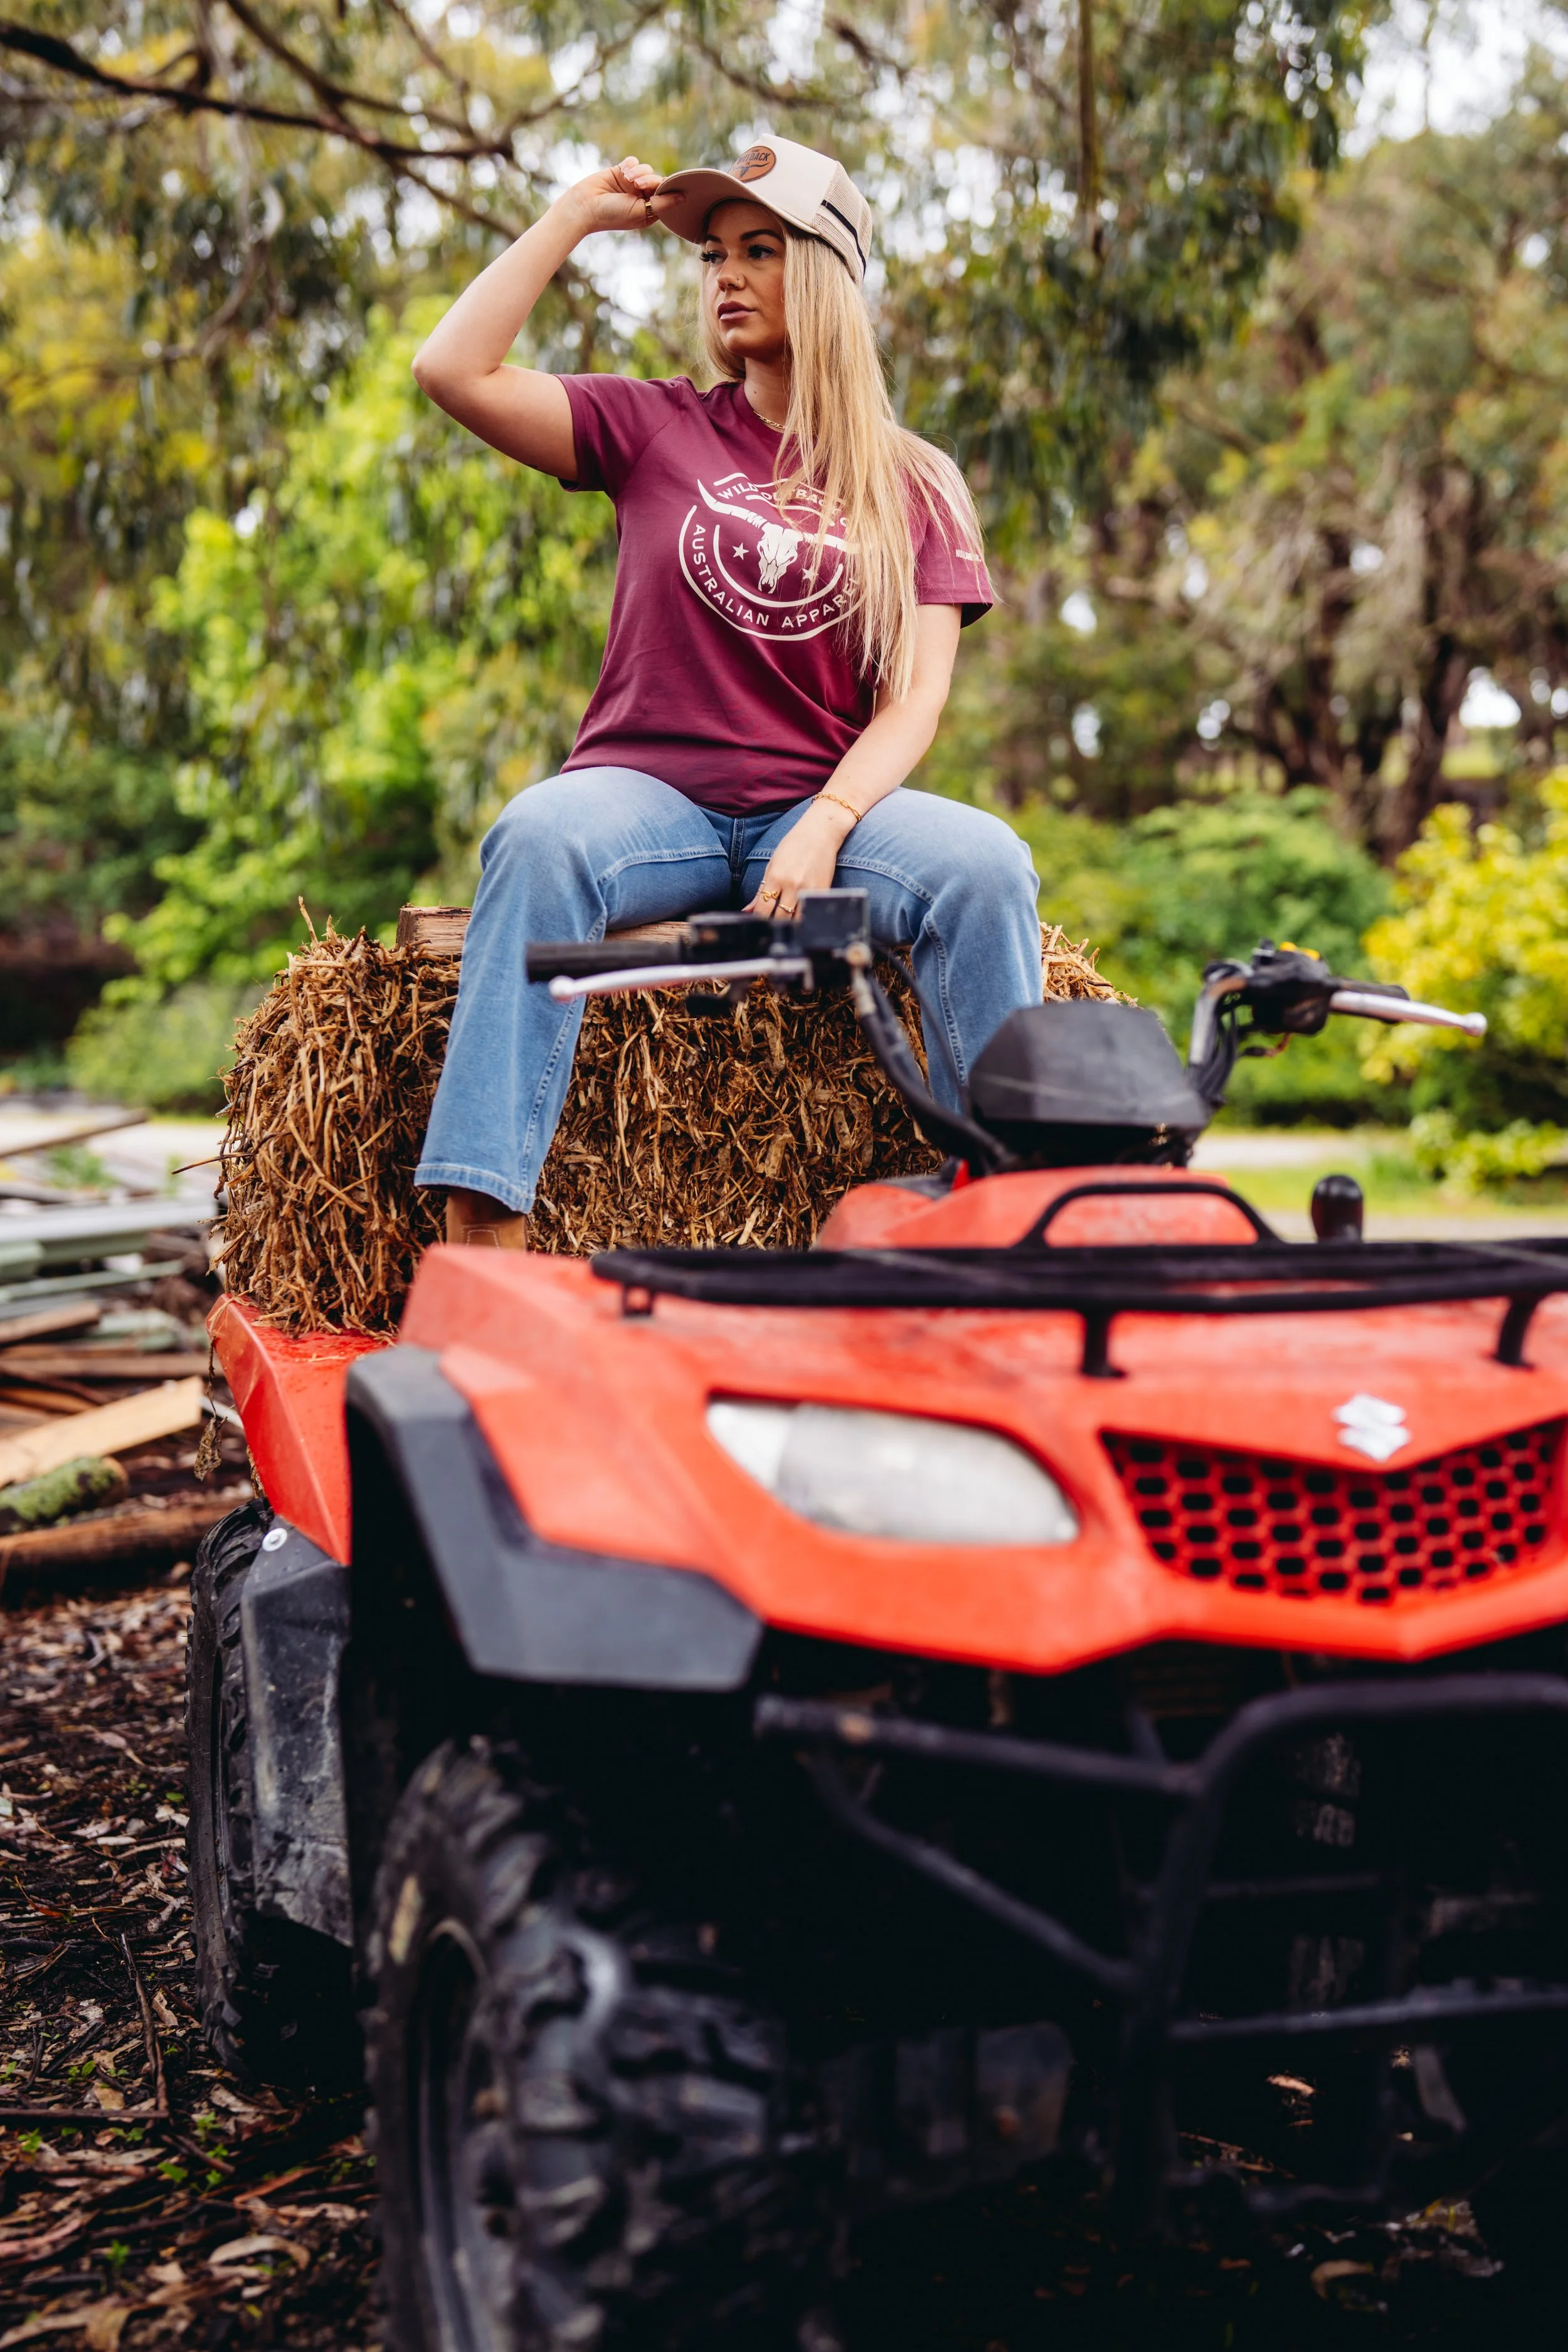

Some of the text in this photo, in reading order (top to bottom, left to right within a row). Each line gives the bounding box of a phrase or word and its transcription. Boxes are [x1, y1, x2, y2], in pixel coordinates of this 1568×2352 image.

[717, 482, 842, 516] WILD OBAC
[692, 524, 770, 627] AUSTRALIAN
